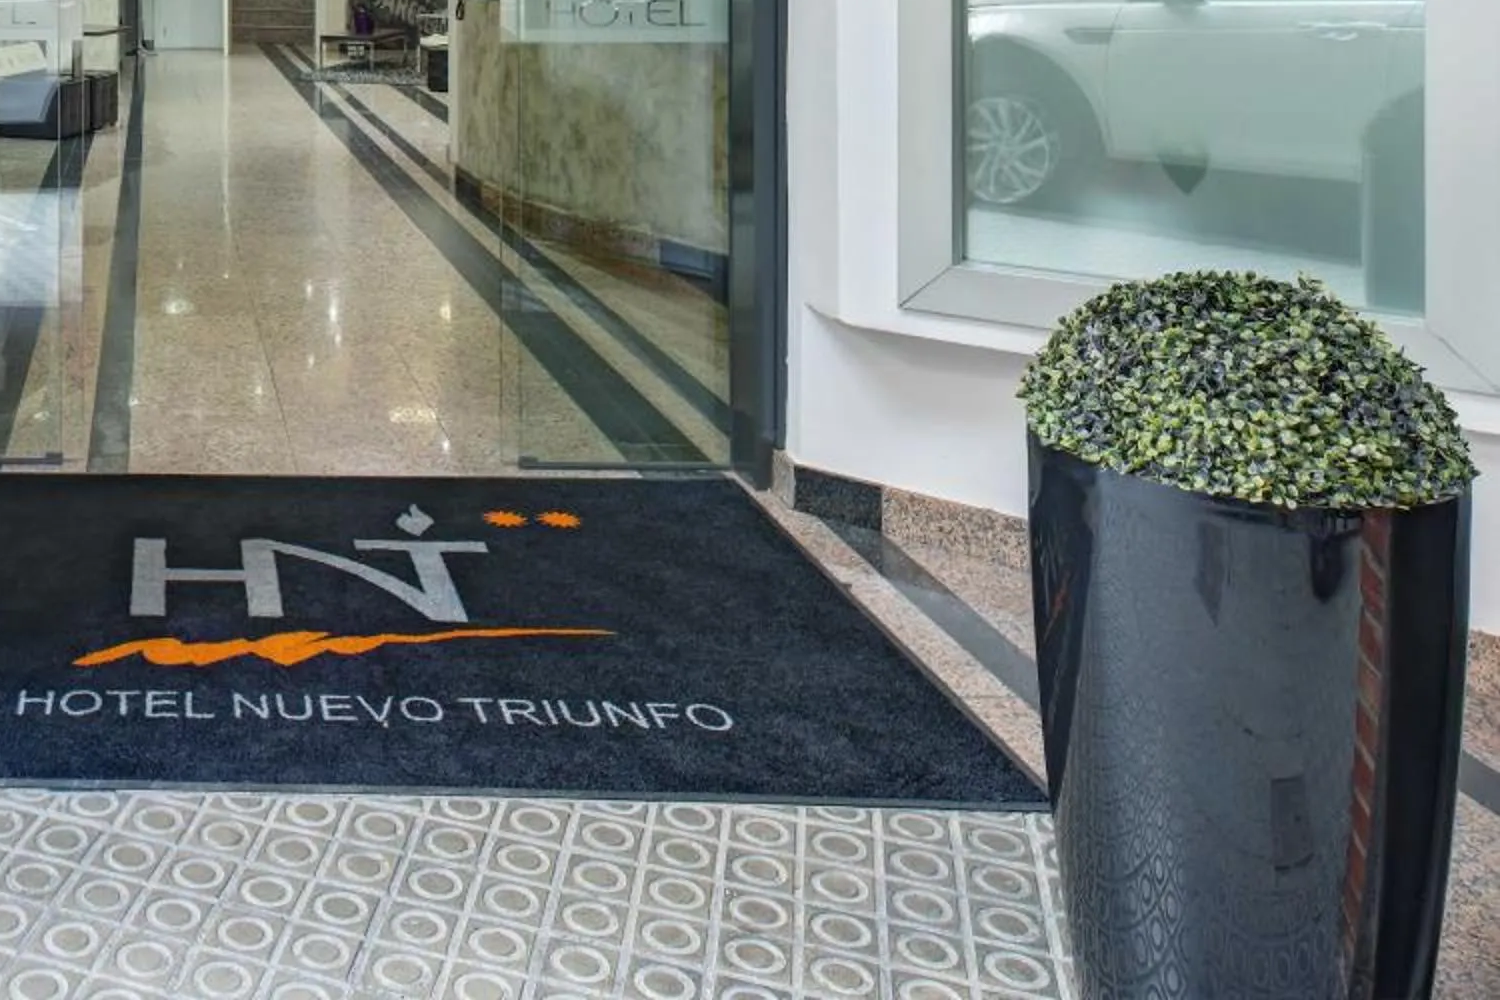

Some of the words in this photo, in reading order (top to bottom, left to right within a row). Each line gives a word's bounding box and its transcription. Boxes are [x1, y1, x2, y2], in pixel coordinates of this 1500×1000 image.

[15, 689, 217, 721] HOTEL
[233, 691, 445, 728] NUEVO
[457, 698, 734, 733] TRIUNFO
